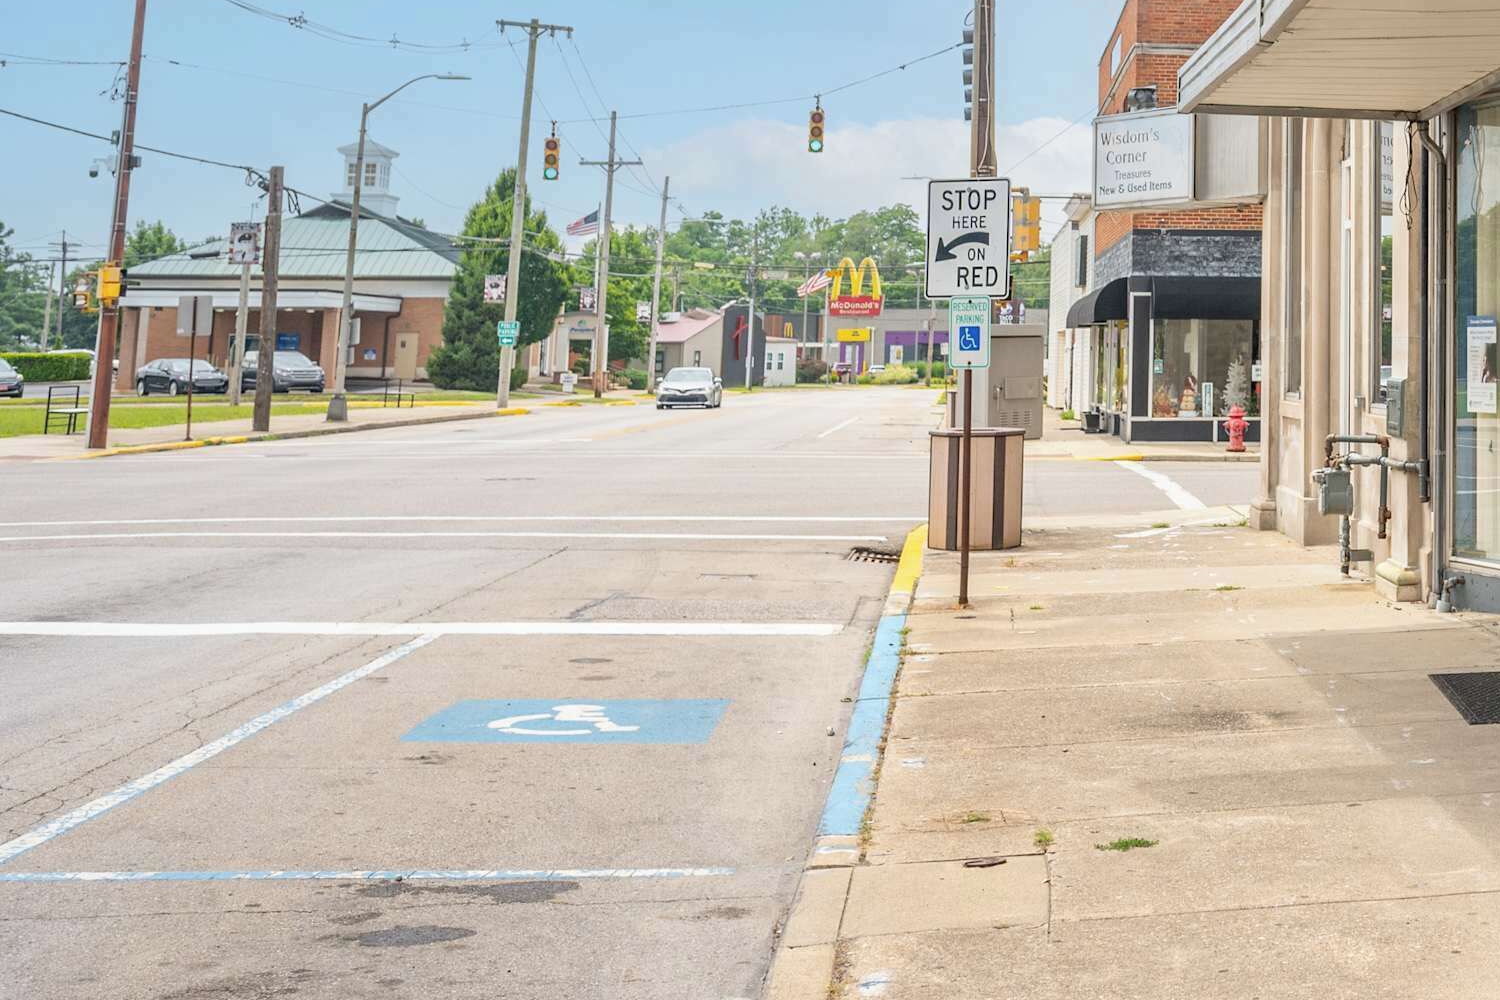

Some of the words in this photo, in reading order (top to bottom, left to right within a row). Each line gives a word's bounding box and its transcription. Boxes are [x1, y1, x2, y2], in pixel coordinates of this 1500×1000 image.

[1101, 128, 1160, 146] Wisdom's
[1106, 151, 1147, 165] Corner
[1114, 169, 1152, 180] Treasures
[1099, 185, 1116, 196] New
[1118, 184, 1125, 194] &
[1127, 181, 1147, 193] Used
[1149, 181, 1173, 191] Items
[942, 189, 997, 211] STOP
[952, 216, 987, 229] HERE
[967, 248, 986, 261] ON
[957, 266, 998, 288] RED
[831, 301, 880, 309] McDonald's
[952, 302, 988, 312] RESERVED
[955, 314, 984, 324] PARKING
